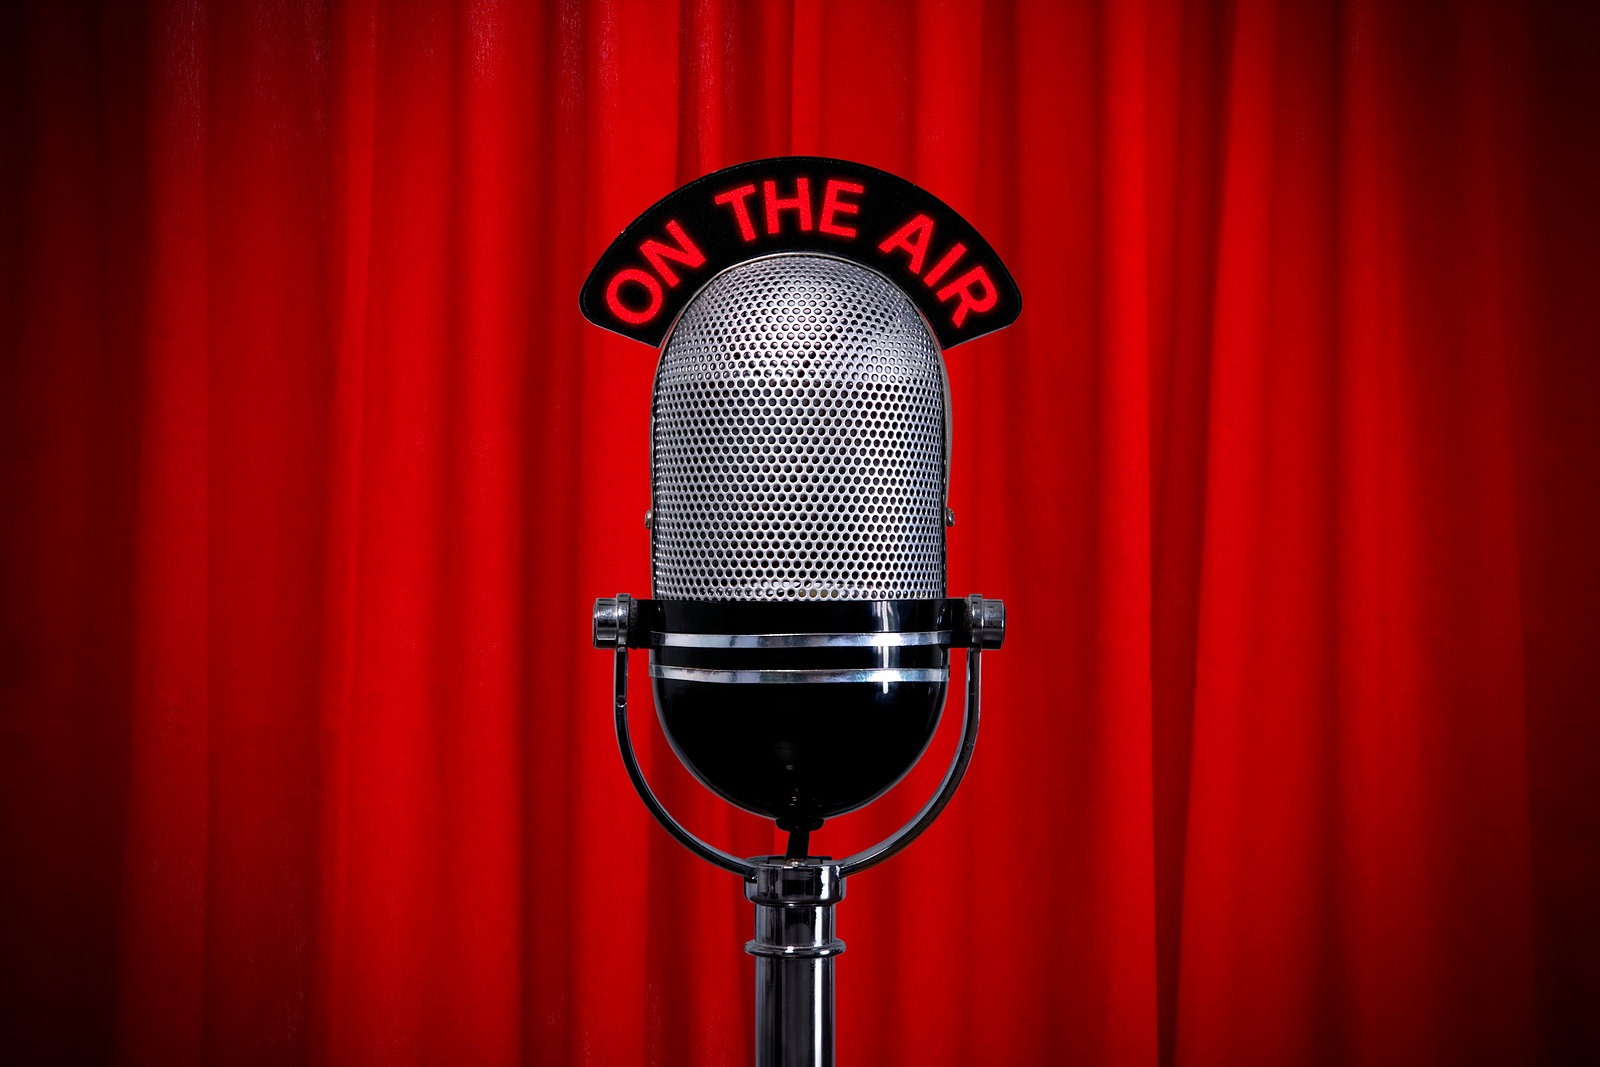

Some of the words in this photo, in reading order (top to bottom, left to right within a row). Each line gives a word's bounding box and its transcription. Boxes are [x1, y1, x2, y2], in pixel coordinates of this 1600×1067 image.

[606, 220, 706, 325] ON
[714, 178, 864, 242] THE
[878, 213, 998, 328] AIR
